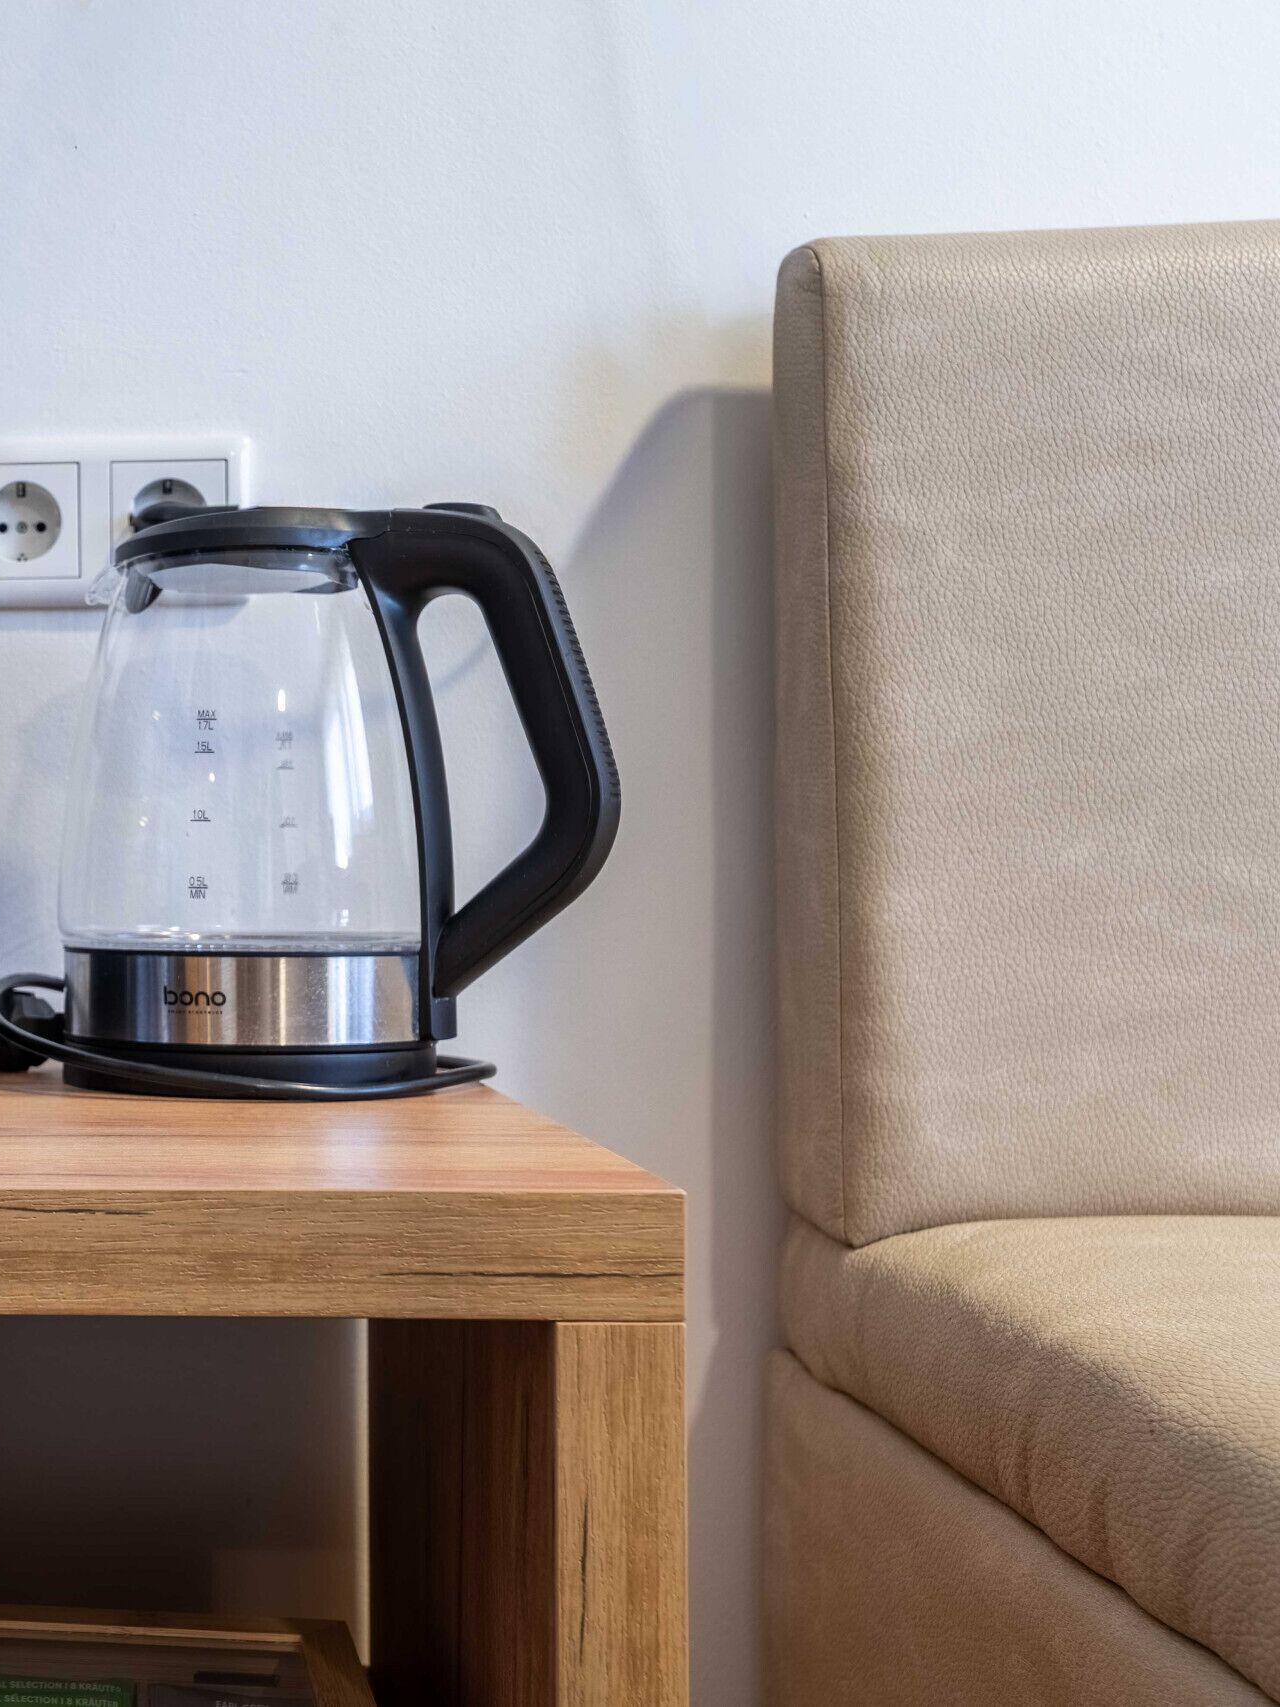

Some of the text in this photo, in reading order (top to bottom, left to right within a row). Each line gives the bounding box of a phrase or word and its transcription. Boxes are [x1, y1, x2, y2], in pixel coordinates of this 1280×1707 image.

[197, 709, 216, 718] MAX
[189, 889, 206, 899] MIN
[163, 985, 227, 1007] bono
[11, 1680, 63, 1689] SELECTION
[4, 1693, 59, 1705] SELECTION
